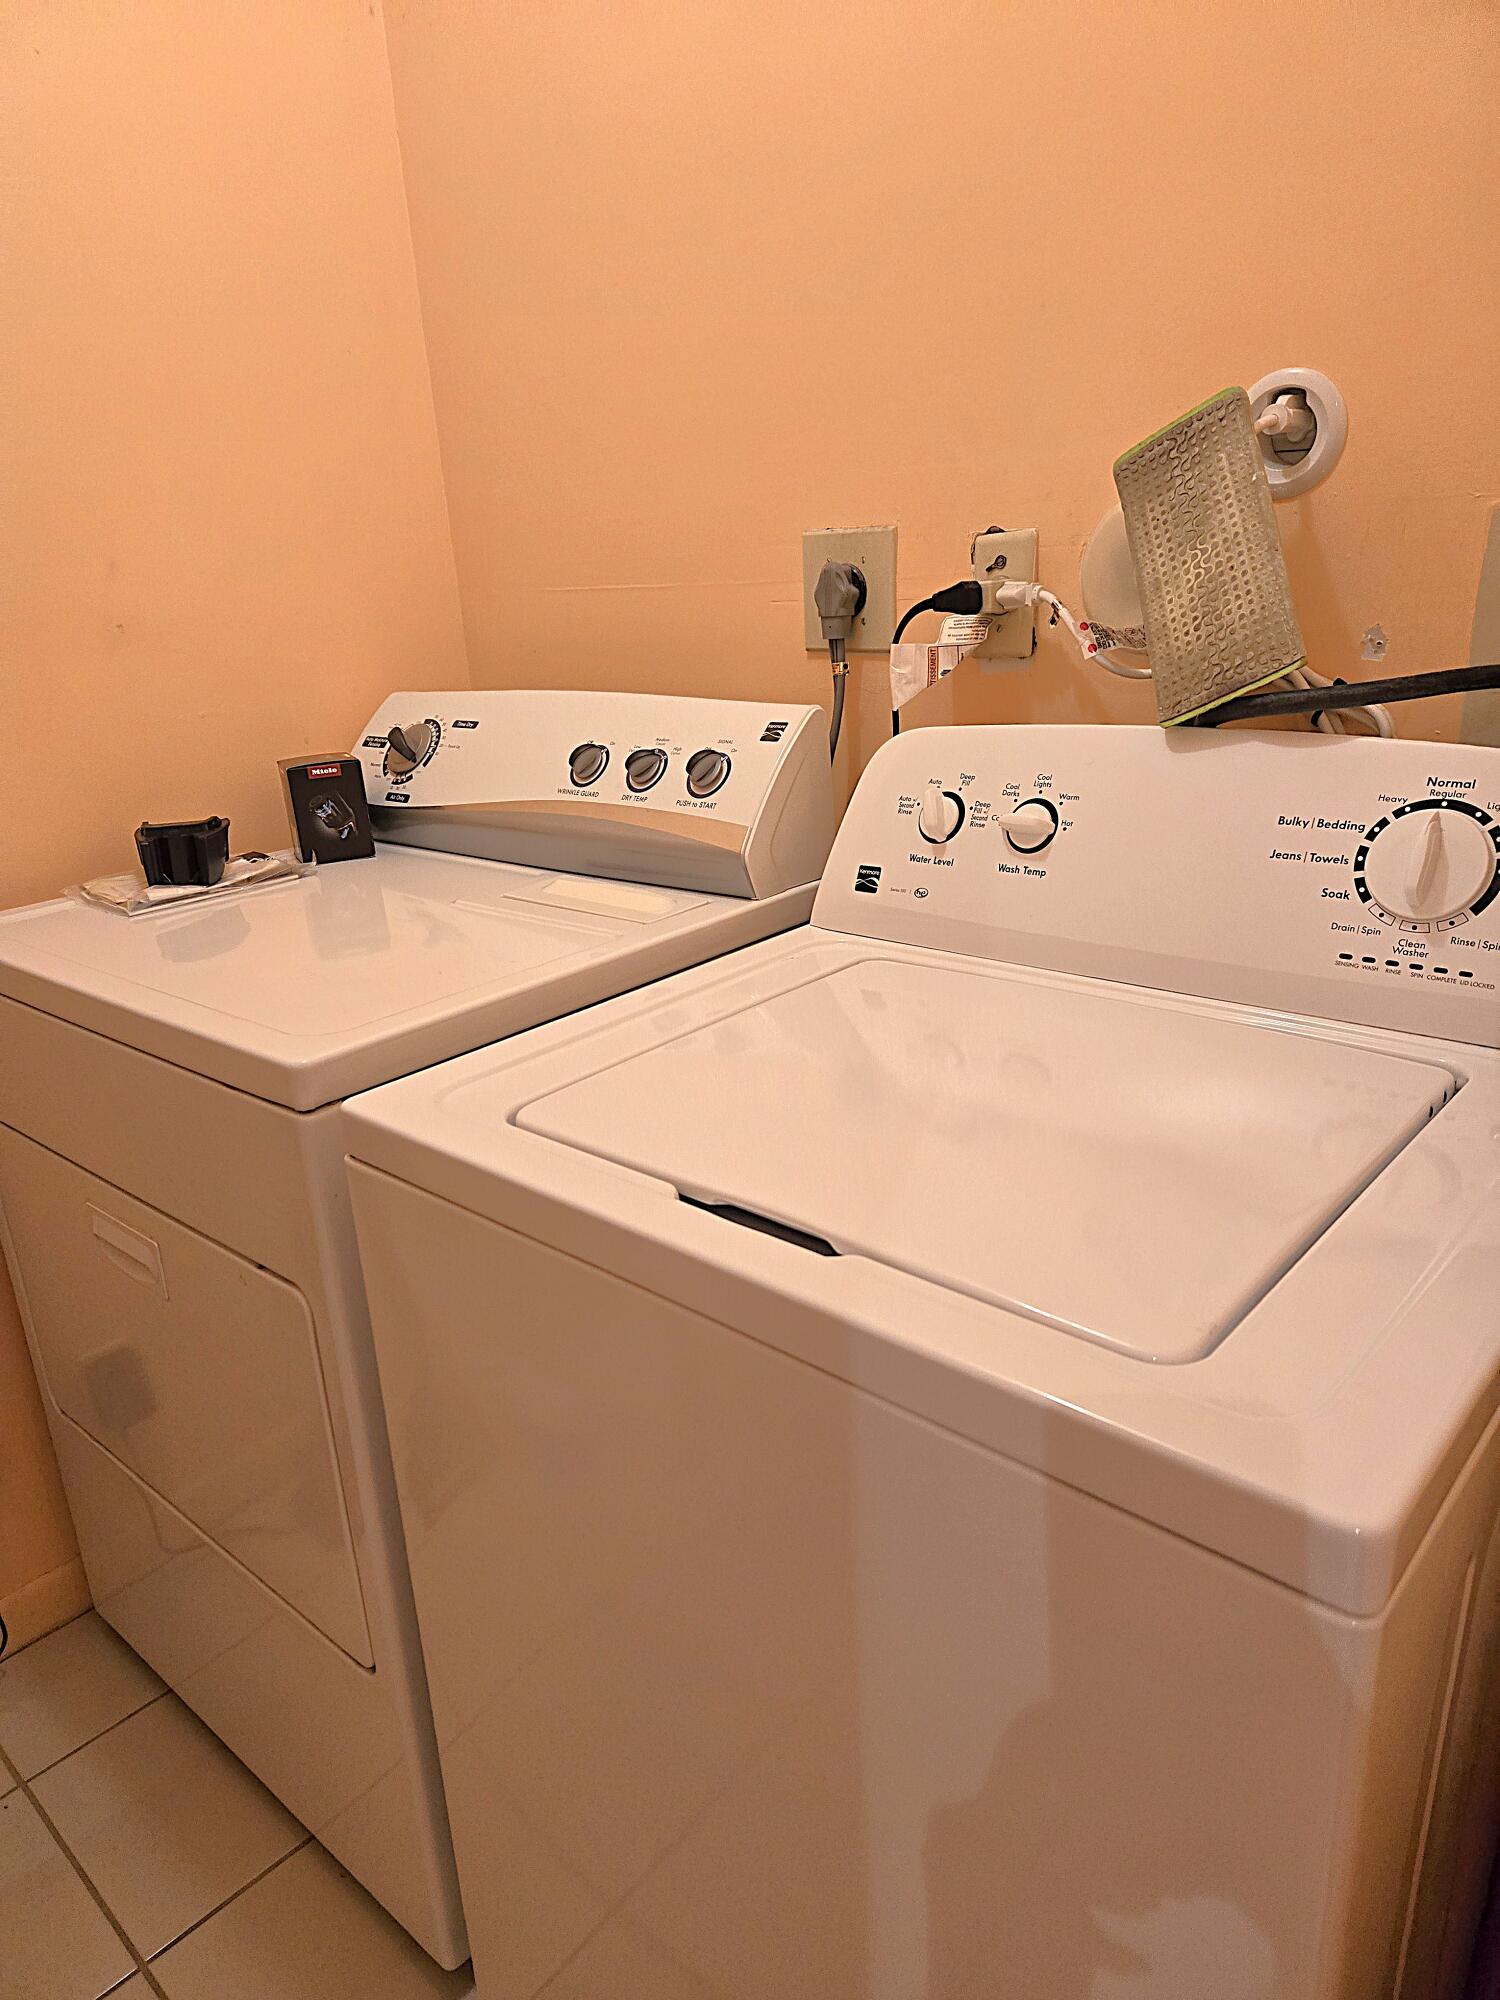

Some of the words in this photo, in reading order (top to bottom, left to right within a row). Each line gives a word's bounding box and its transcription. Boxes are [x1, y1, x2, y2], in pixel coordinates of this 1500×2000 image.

[960, 773, 975, 781] Deep
[1037, 773, 1052, 781] Cool
[1033, 780, 1052, 789] Lights
[1426, 776, 1477, 789] Normal
[557, 788, 580, 797] WRINKLE
[581, 789, 600, 798] GUARD
[1002, 789, 1020, 797] Darks
[1059, 793, 1080, 801] Warm
[1429, 788, 1467, 799] Regular
[1378, 794, 1409, 804] Heavy
[676, 800, 691, 808] PUSH
[698, 801, 717, 810] START
[975, 800, 991, 809] Deep
[970, 820, 986, 828] Rinse
[1277, 816, 1310, 830] Bulky
[1316, 818, 1366, 833] Bedding
[909, 853, 931, 864] Water
[933, 856, 954, 867] Level
[1269, 849, 1302, 861] Jeans
[1309, 852, 1349, 865] Towels
[859, 868, 880, 876] Kenmore
[998, 863, 1020, 874] Wash
[1023, 865, 1047, 879] Temp
[1321, 887, 1351, 900] Soak
[1331, 921, 1356, 933] Drain
[1361, 925, 1382, 936] Spin
[1398, 938, 1426, 949] Clean
[1450, 936, 1476, 947] Rinse
[1392, 946, 1430, 959] Washer
[1334, 960, 1359, 969] SENSING
[1361, 964, 1379, 972] WASH
[1385, 967, 1401, 976] RINSE
[1410, 971, 1424, 979] SPIN
[1426, 974, 1457, 984] COMPLETE
[1470, 980, 1495, 990] LOCKED
